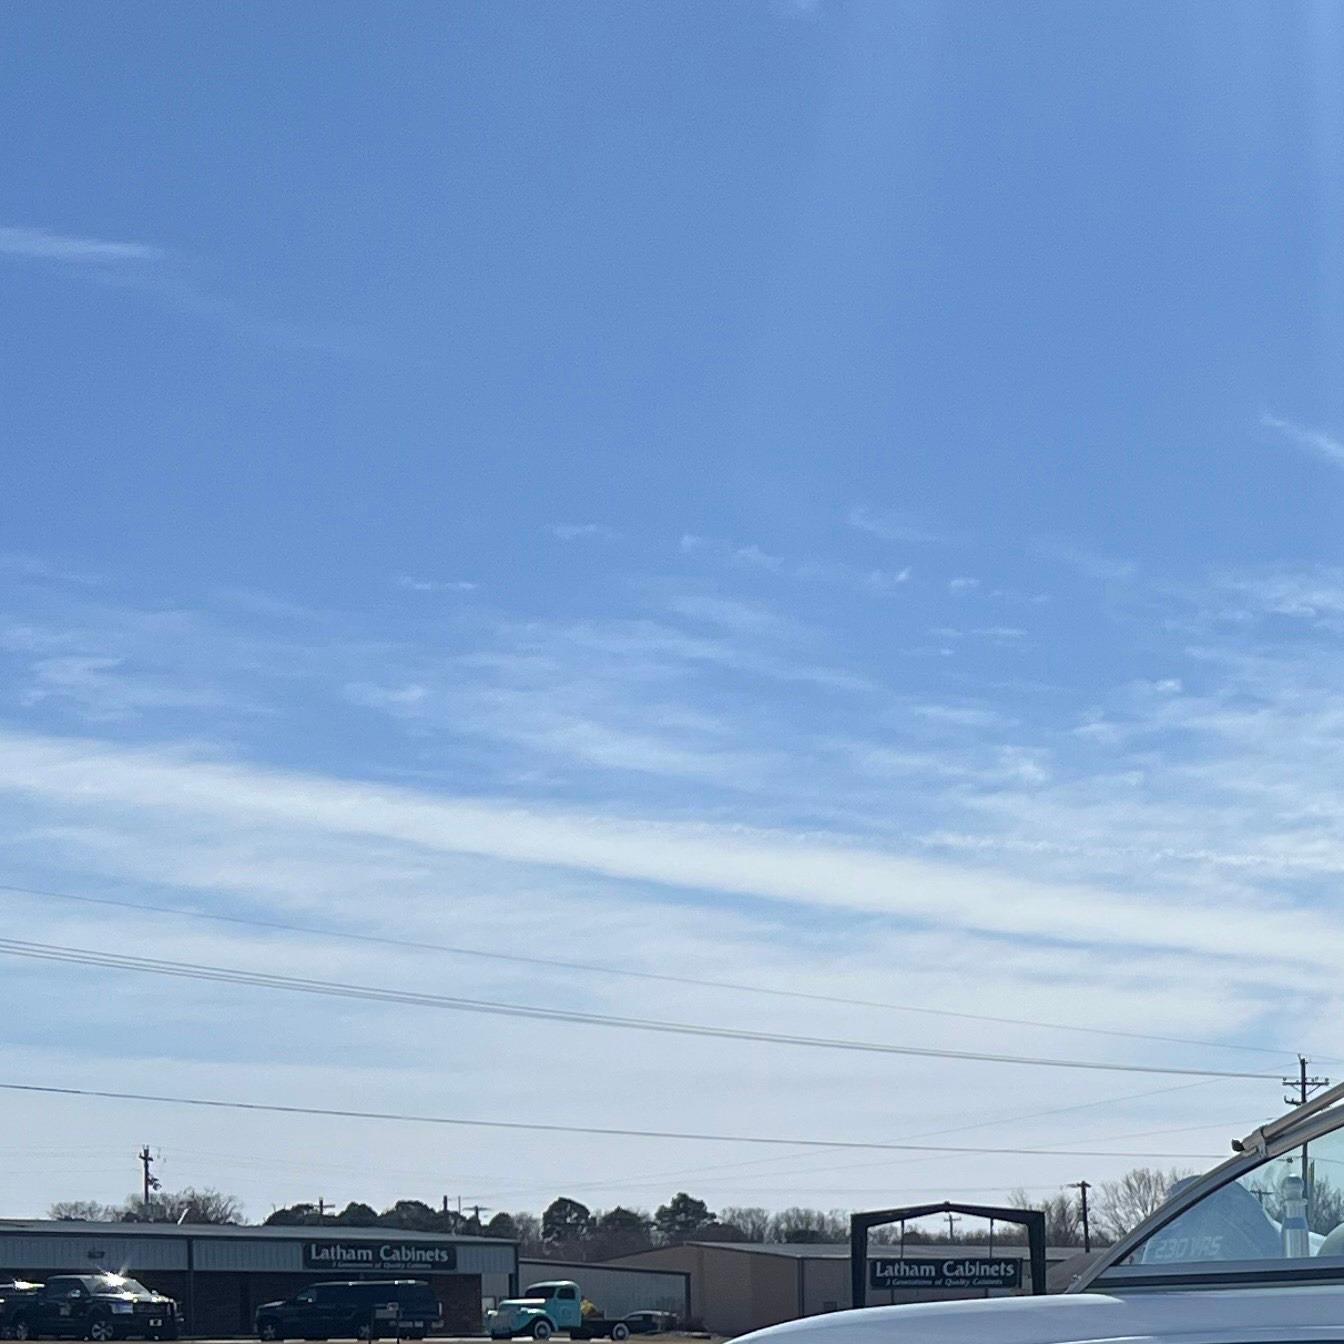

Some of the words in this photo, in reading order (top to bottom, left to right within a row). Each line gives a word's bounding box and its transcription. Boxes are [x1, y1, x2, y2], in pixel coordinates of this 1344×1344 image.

[310, 1243, 373, 1261] Latham
[379, 1244, 449, 1262] Cabinets
[875, 1260, 936, 1277] Latham
[942, 1260, 1015, 1277] Cabinets
[944, 1278, 971, 1288] Quality
